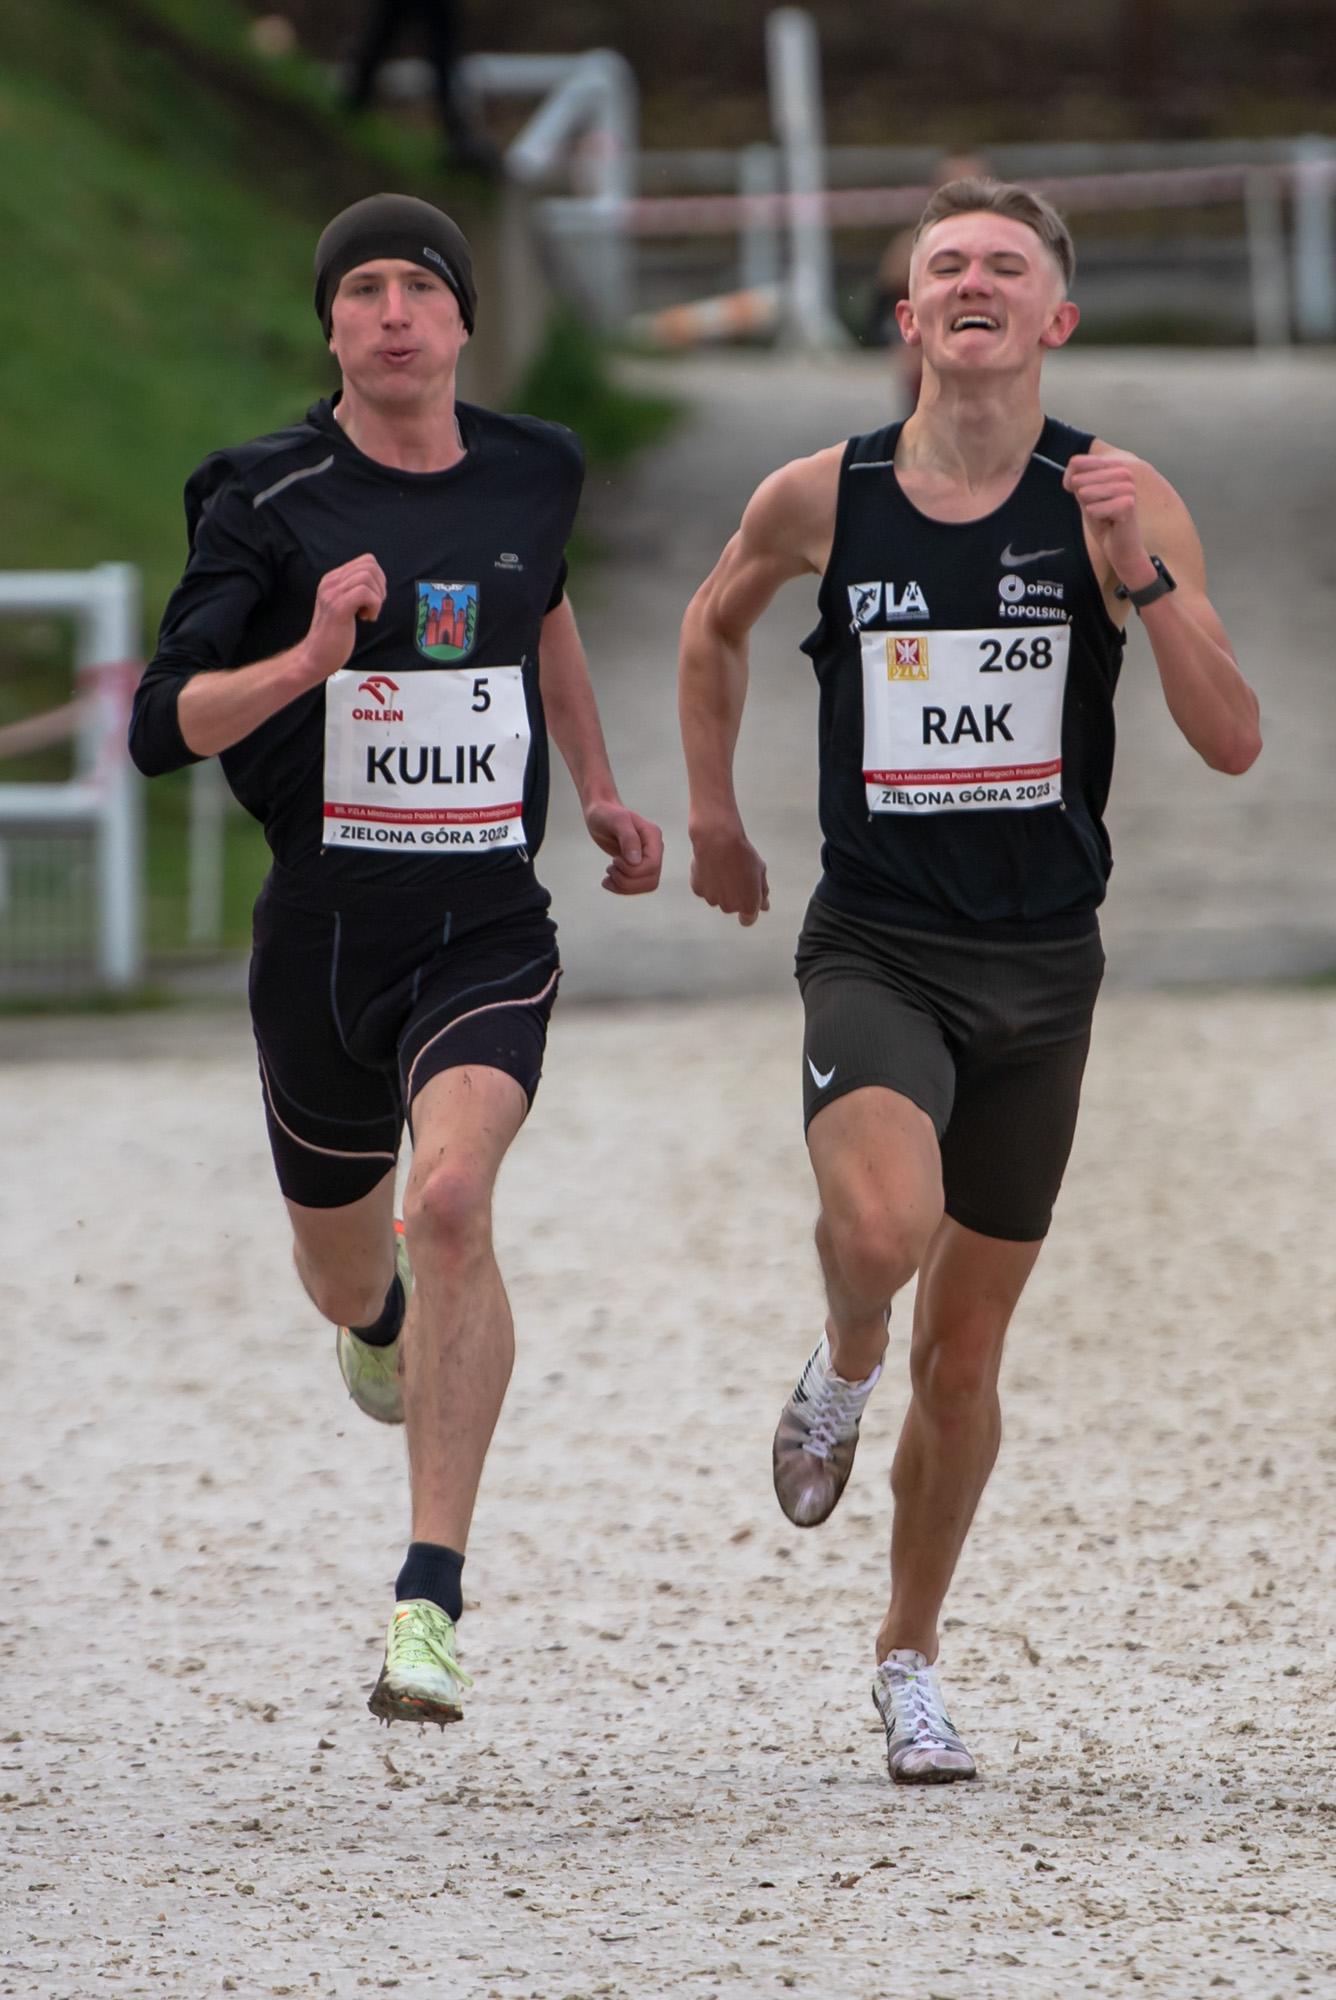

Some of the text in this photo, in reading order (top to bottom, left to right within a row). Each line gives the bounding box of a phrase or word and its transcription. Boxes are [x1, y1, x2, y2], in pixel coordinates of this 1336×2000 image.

[1027, 584, 1064, 600] OPOLE
[1007, 605, 1067, 620] OPOLSKIE
[979, 636, 1053, 673] 268
[889, 666, 926, 678] PZLA
[471, 677, 491, 712] 5
[352, 708, 404, 721] ORLEN
[922, 703, 1014, 745] RAK
[366, 743, 496, 785] KULIK
[951, 770, 974, 780] Polski
[983, 768, 1014, 779] Biegach
[881, 781, 1050, 805] ZIELONA GÓRA 2023
[340, 820, 509, 844] ZIELONA GÓRA 2023
